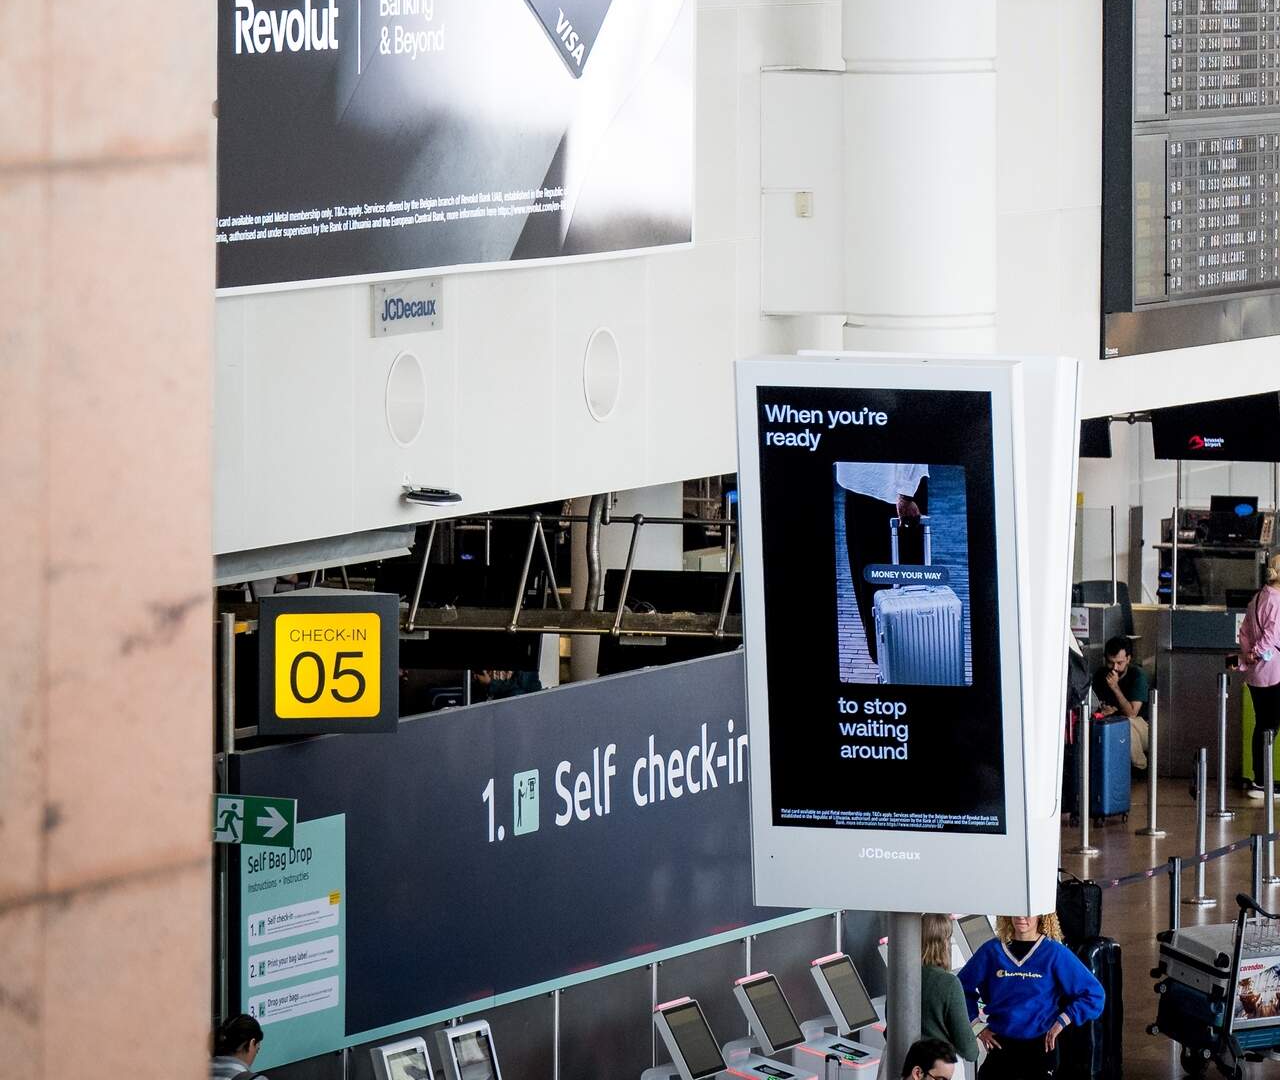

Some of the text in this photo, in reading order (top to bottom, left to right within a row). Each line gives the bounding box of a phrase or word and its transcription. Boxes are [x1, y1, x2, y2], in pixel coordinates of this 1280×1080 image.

[380, 25, 445, 60] & Beyond
[553, 8, 585, 67] VISA
[1223, 56, 1239, 67] BERLIN
[1223, 74, 1239, 85] PRAGUE
[1222, 176, 1250, 188] CASABLANCA
[1222, 215, 1239, 226] LISBON
[1223, 232, 1244, 245] ISTANBUL
[1222, 251, 1244, 263] ALICANTE
[1222, 269, 1247, 282] FRANKFURT
[381, 298, 436, 322] JCDecaux
[765, 404, 888, 430] When you're
[766, 429, 821, 452] ready
[871, 570, 942, 580] MONEY YOUR WAY
[289, 628, 367, 643] CHECK-IN
[290, 651, 366, 704] 05
[838, 697, 907, 719] to stop
[839, 720, 909, 743] waiting
[840, 743, 908, 760] around
[482, 778, 505, 843] 1.
[554, 743, 616, 827] Self
[248, 847, 313, 874] Self Bag Drop
[858, 848, 921, 861] JCDecaux
[248, 877, 277, 893] Instructions
[250, 924, 257, 937] 1.
[250, 964, 257, 978] 2.
[996, 969, 1043, 980] Champion
